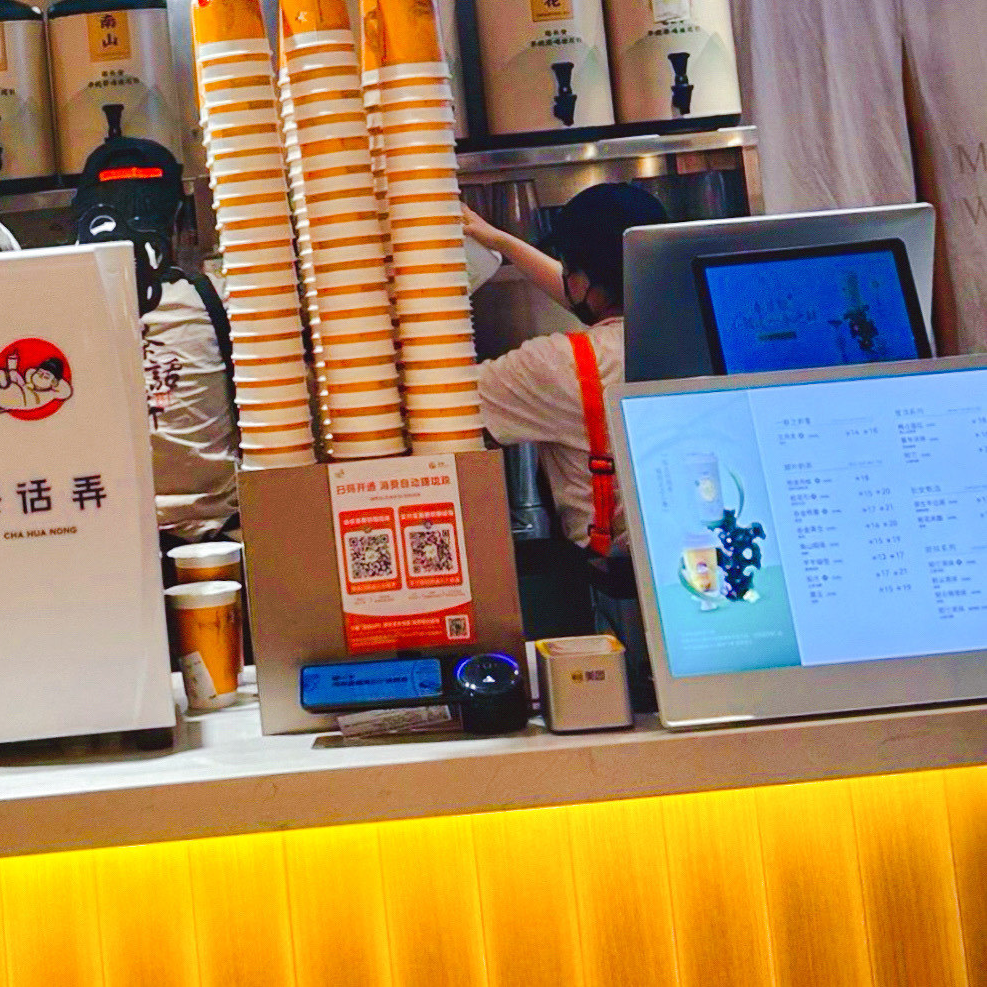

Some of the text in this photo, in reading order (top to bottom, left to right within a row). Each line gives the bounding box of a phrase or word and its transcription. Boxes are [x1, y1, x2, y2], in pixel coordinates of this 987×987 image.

[100, 14, 118, 48] 南山
[3, 526, 78, 540] CHA HUA NONG
